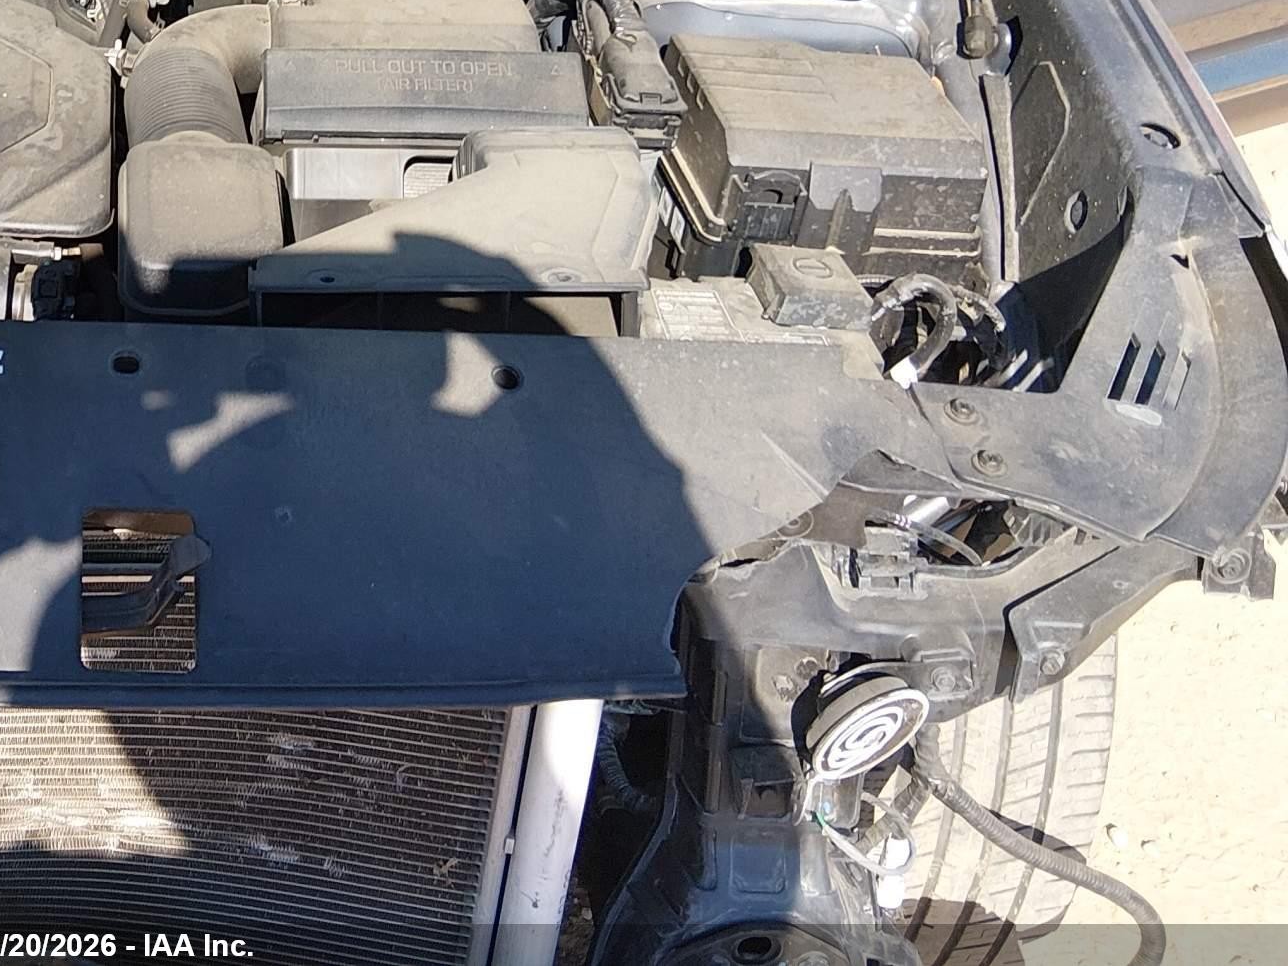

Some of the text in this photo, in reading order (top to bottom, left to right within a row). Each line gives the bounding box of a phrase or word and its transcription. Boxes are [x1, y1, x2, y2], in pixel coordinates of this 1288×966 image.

[335, 59, 513, 76] PULL OUT TO OPEN
[377, 77, 473, 93] (AIR FILTER)
